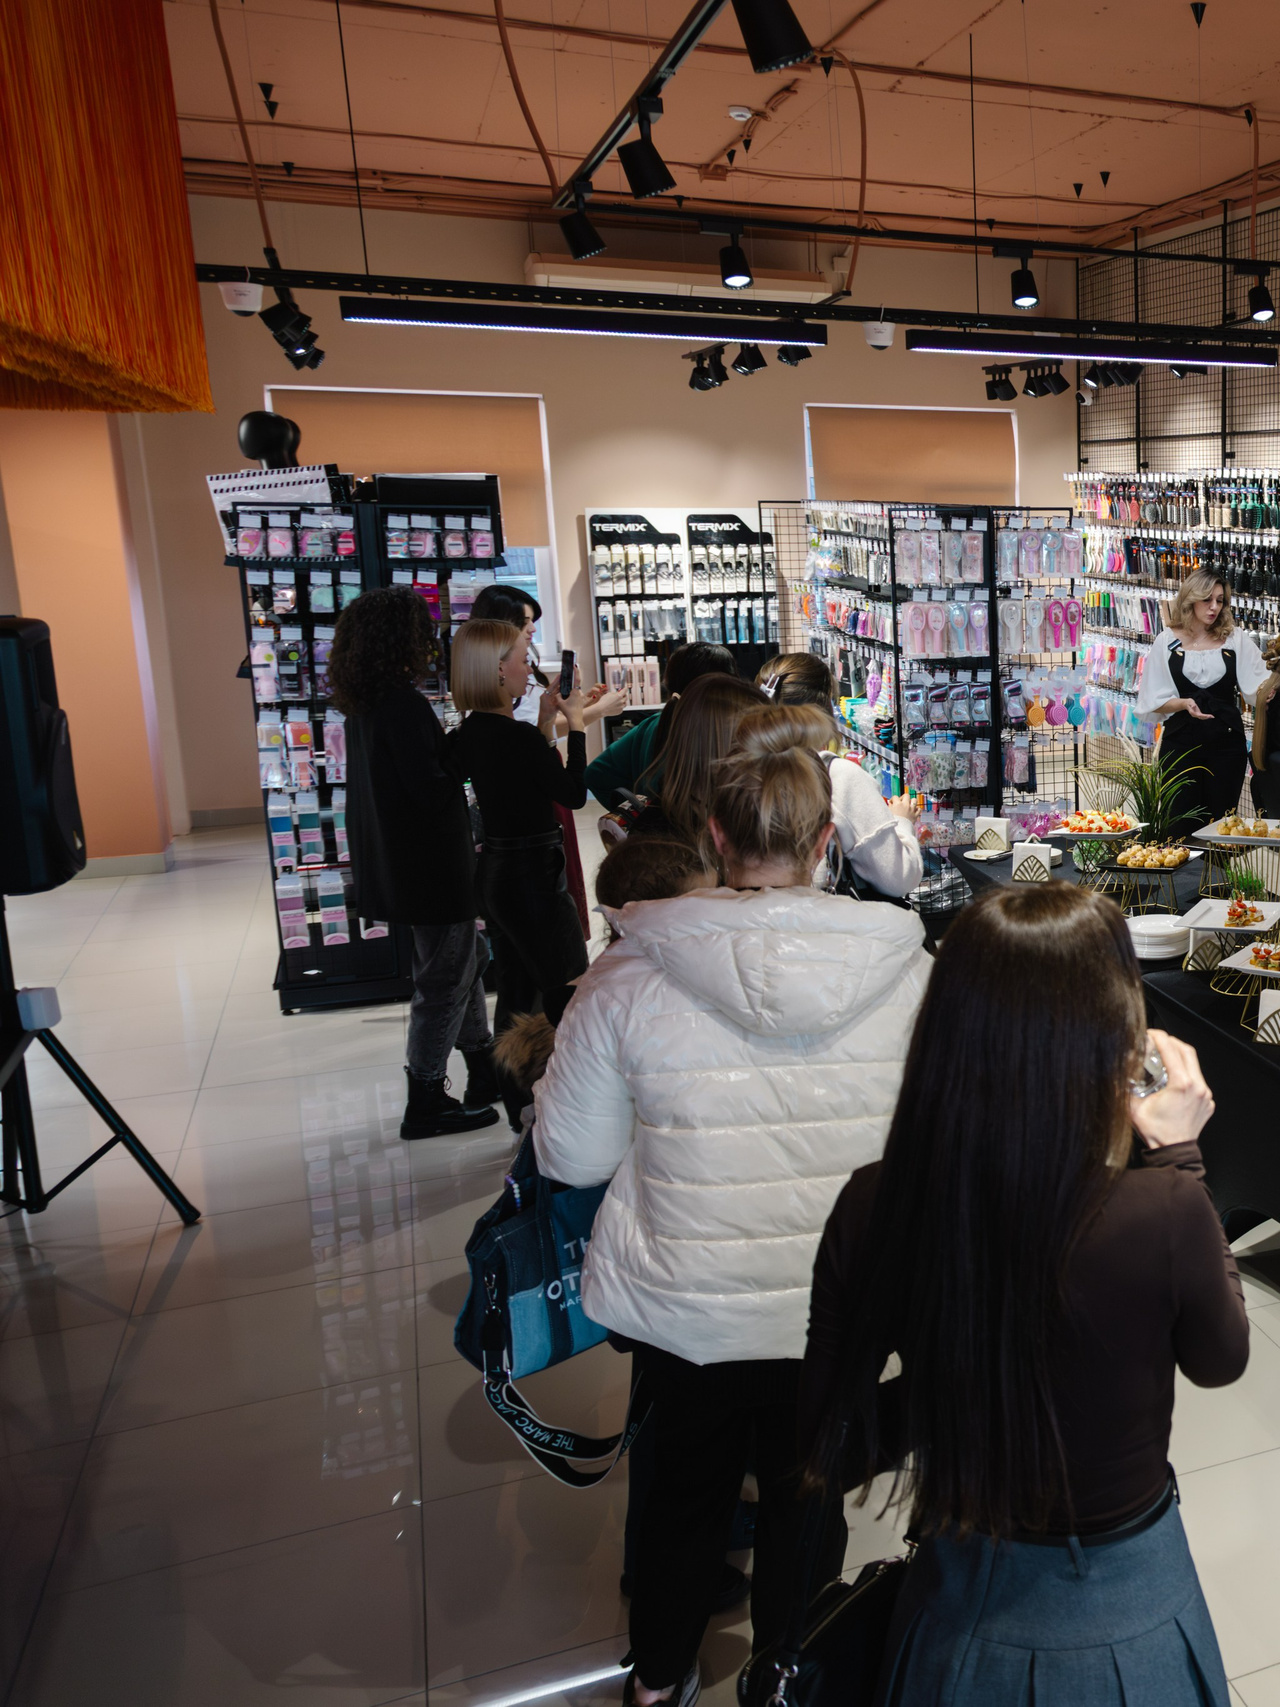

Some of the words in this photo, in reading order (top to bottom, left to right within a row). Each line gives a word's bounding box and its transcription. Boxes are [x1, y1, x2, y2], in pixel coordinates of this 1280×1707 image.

[592, 523, 648, 534] TERMIX
[688, 522, 741, 533] TERMIX
[563, 1236, 589, 1260] TH
[547, 1271, 580, 1300] OT
[559, 1295, 583, 1311] MAR
[489, 1382, 518, 1415] JACO
[514, 1416, 555, 1444] MARC
[551, 1433, 575, 1451] THE
